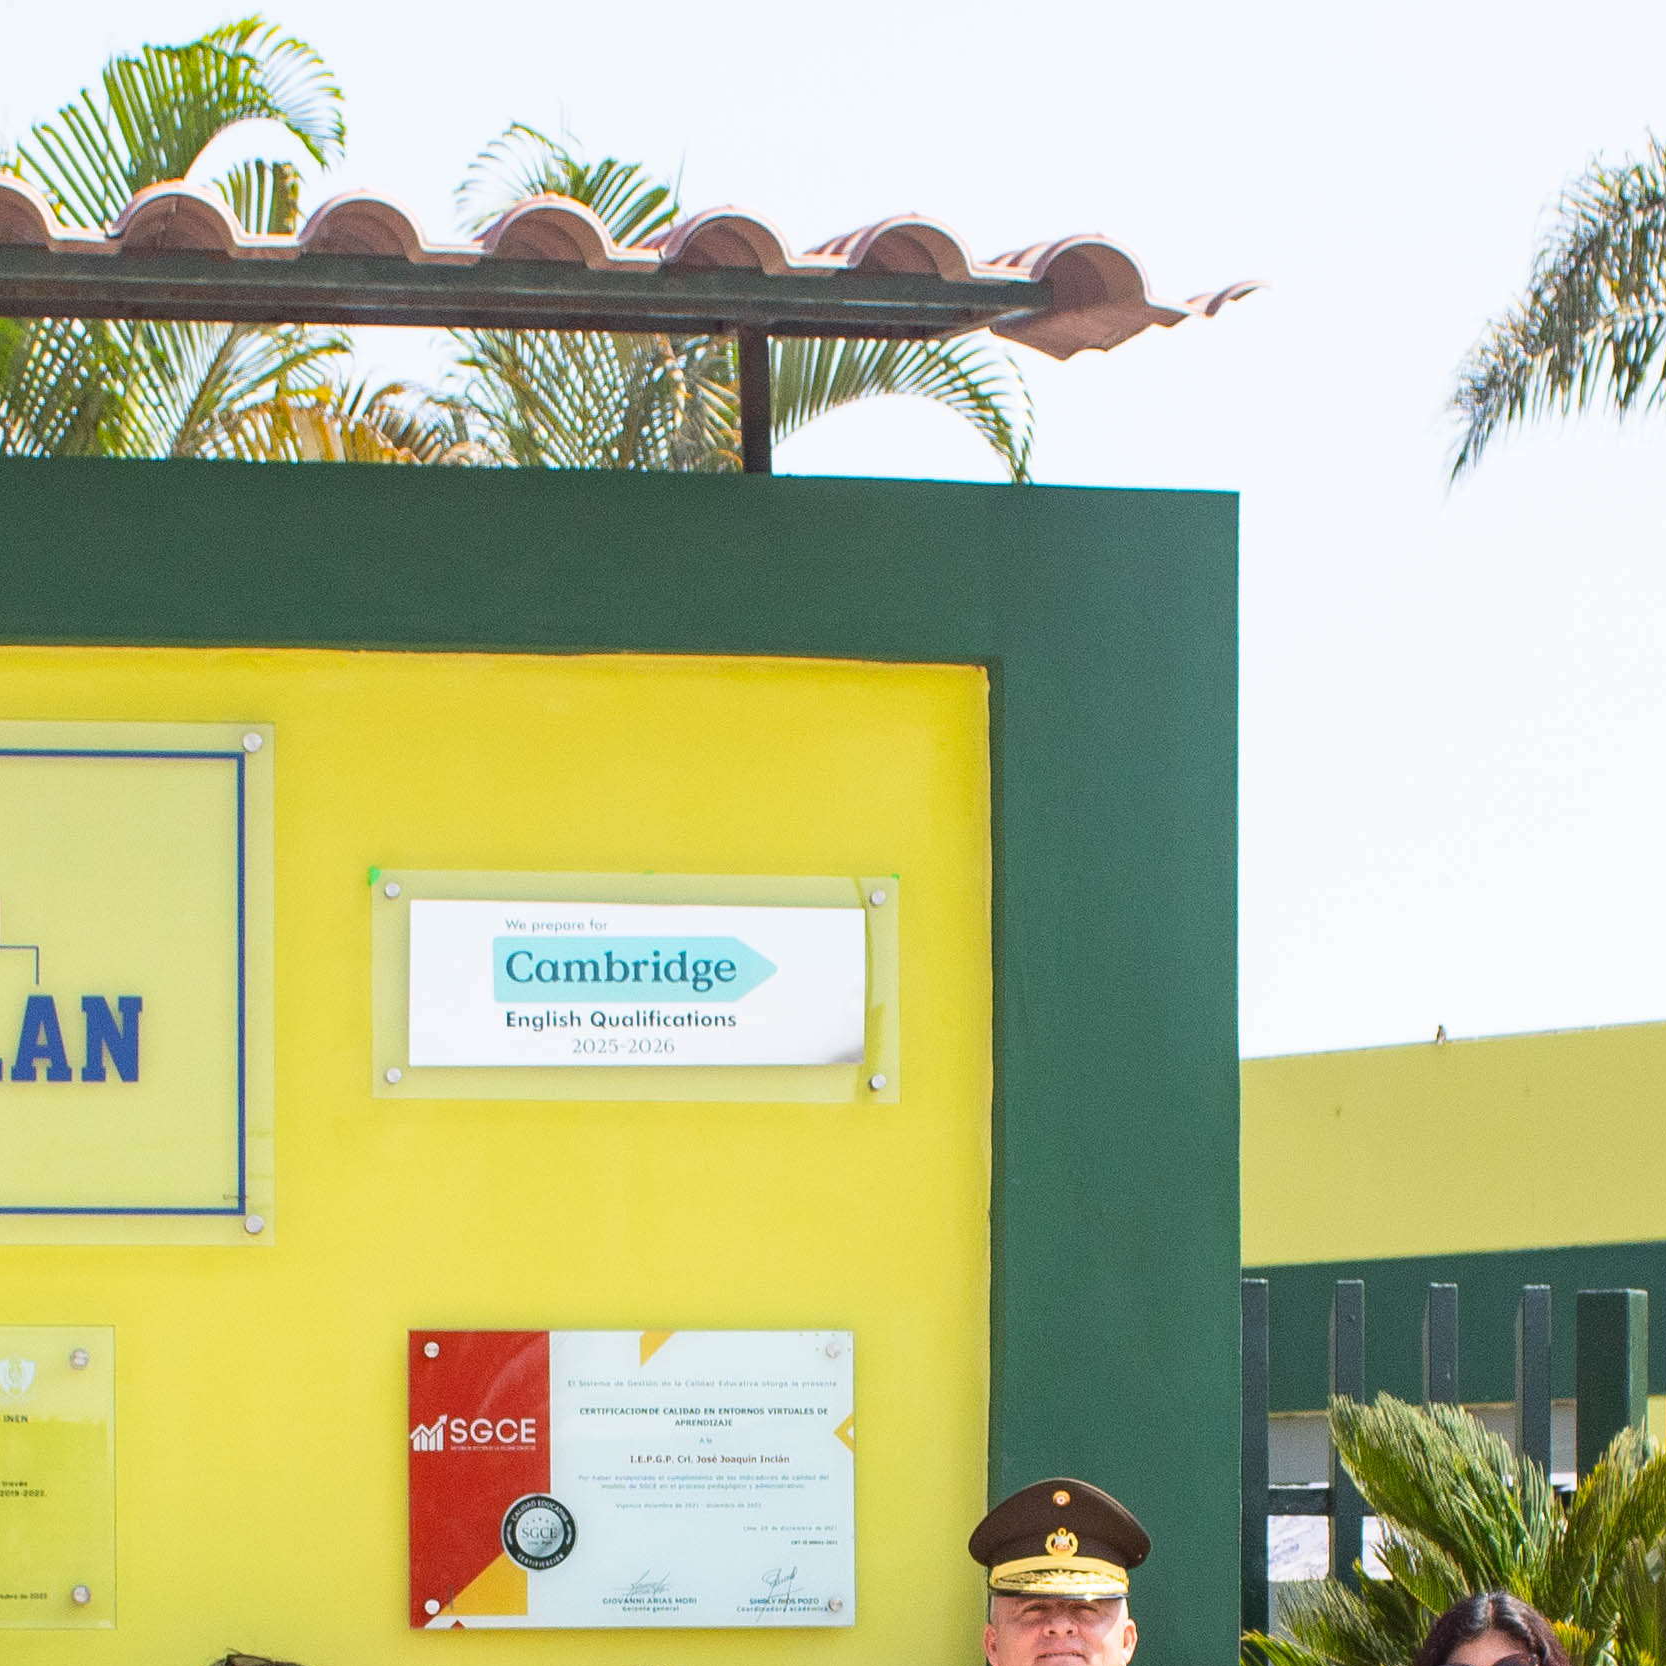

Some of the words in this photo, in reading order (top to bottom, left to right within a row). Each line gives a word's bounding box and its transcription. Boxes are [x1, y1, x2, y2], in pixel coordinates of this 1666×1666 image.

[505, 919, 527, 931] We
[531, 921, 585, 933] prepare
[589, 919, 609, 931] for
[505, 949, 737, 992] Cambridge
[506, 1010, 582, 1032] English
[590, 1010, 737, 1030] Qualifications
[572, 1037, 676, 1055] 2025-2026
[648, 1407, 660, 1415] DE
[663, 1407, 701, 1415] CALIDAD
[704, 1407, 715, 1415] EN
[718, 1407, 765, 1415] ENTORNOS
[767, 1407, 814, 1415] VIRTUALES
[817, 1407, 829, 1415] DE
[675, 1419, 732, 1427] APRENDIZAJE
[449, 1417, 537, 1444] SGCE
[695, 1454, 718, 1464] José
[760, 1454, 790, 1464] Inclán
[522, 1526, 558, 1540] SGCE
